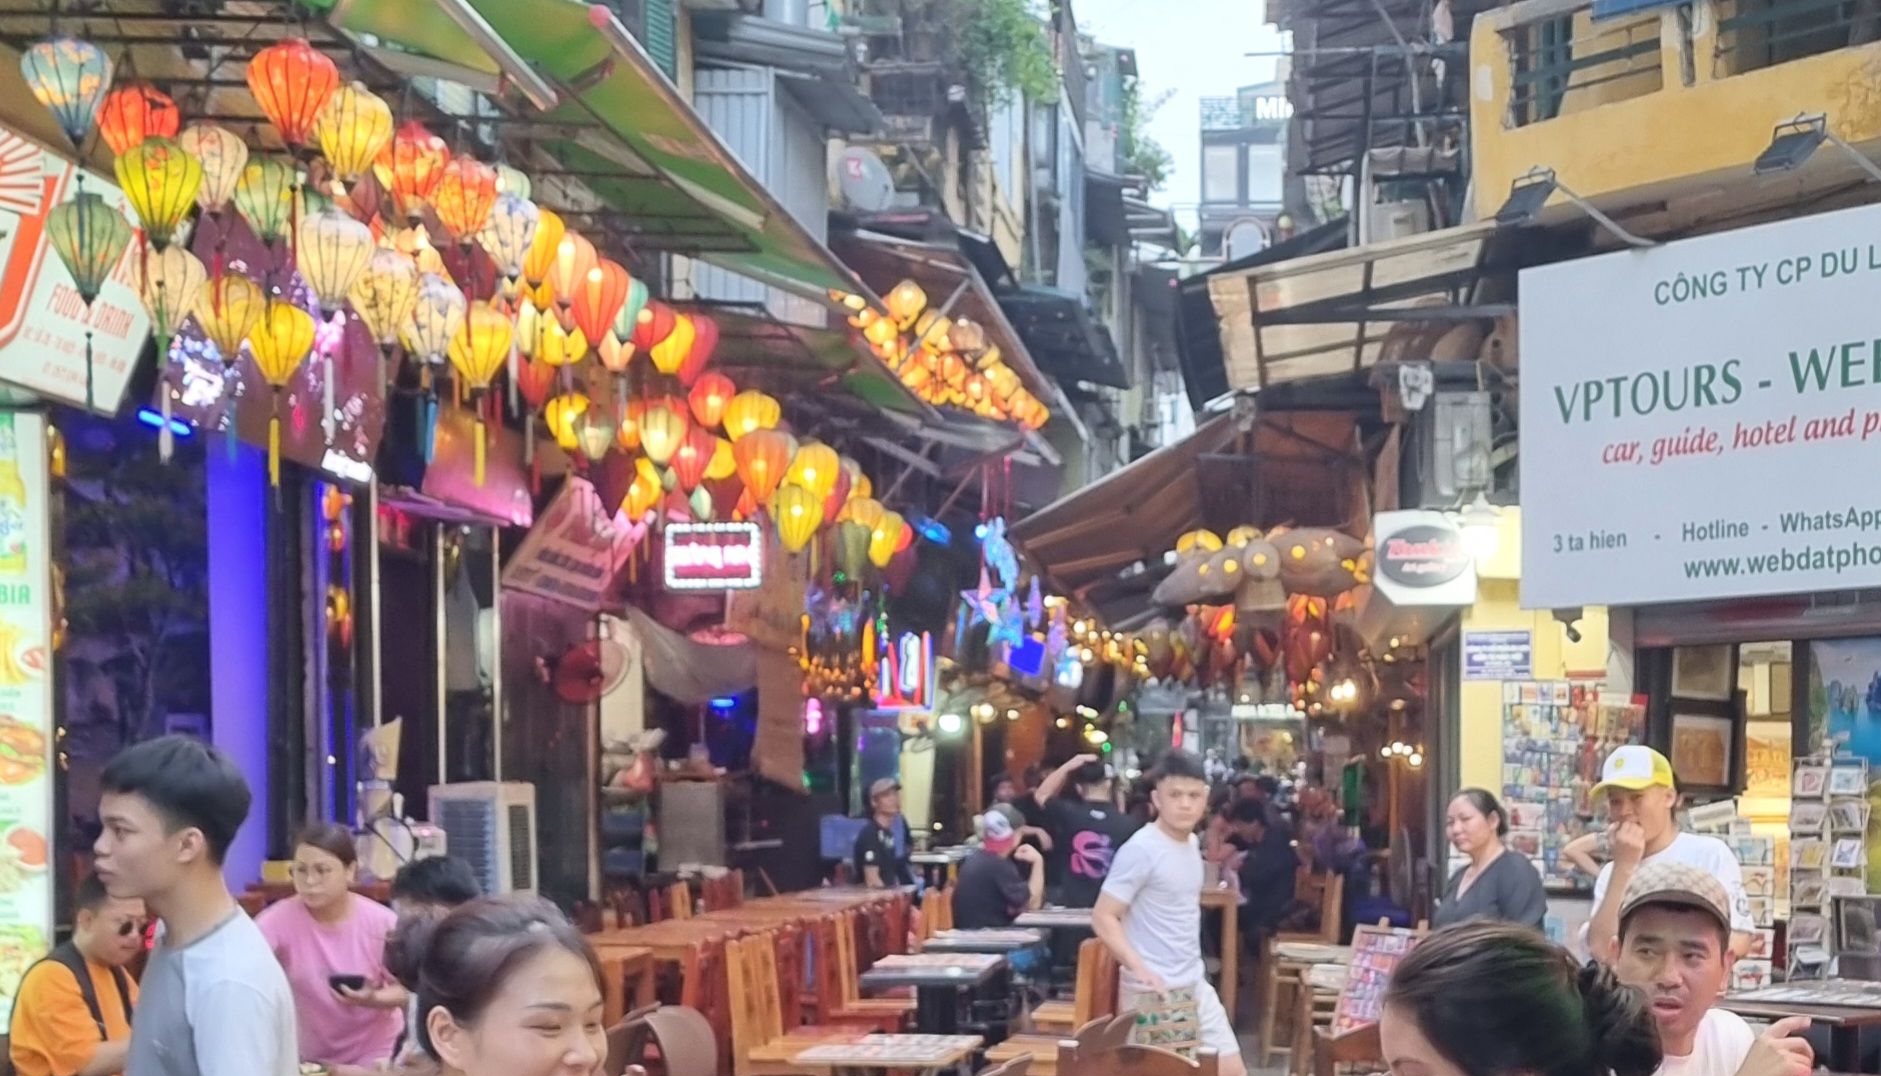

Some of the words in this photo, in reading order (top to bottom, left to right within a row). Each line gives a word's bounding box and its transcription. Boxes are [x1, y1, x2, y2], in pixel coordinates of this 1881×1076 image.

[1654, 271, 1728, 306] CÔNG
[1736, 263, 1768, 292] TY
[1776, 256, 1812, 286] CP
[1821, 247, 1858, 278] DU
[1554, 359, 1742, 424] VPTOURS
[1602, 443, 1643, 464] car,
[1651, 427, 1724, 466] guide,
[1733, 415, 1797, 450] hotel
[1804, 407, 1856, 441] and
[1554, 534, 1563, 553] 3
[1568, 535, 1584, 552] ta
[1590, 530, 1627, 549] hien
[1682, 519, 1749, 542] Hotline
[1684, 542, 1881, 579] www.webdatpho
